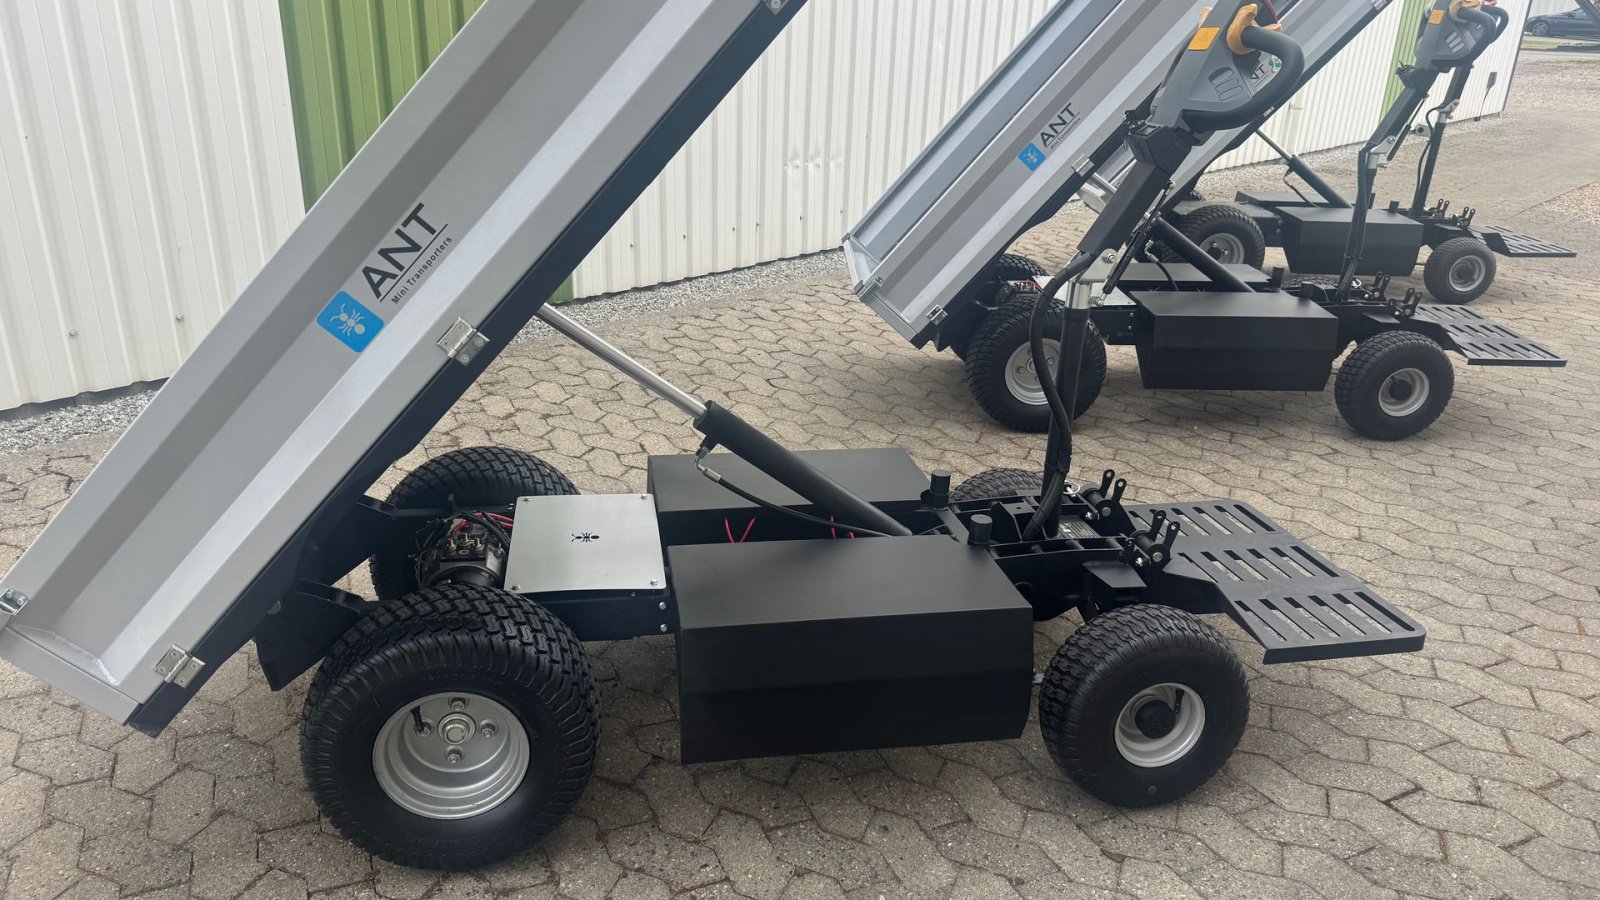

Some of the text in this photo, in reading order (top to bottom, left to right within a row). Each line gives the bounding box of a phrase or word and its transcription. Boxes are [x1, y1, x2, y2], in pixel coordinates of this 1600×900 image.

[1040, 102, 1074, 147] ANT
[362, 202, 436, 299] ANT
[391, 236, 452, 304] Mini Transporters
